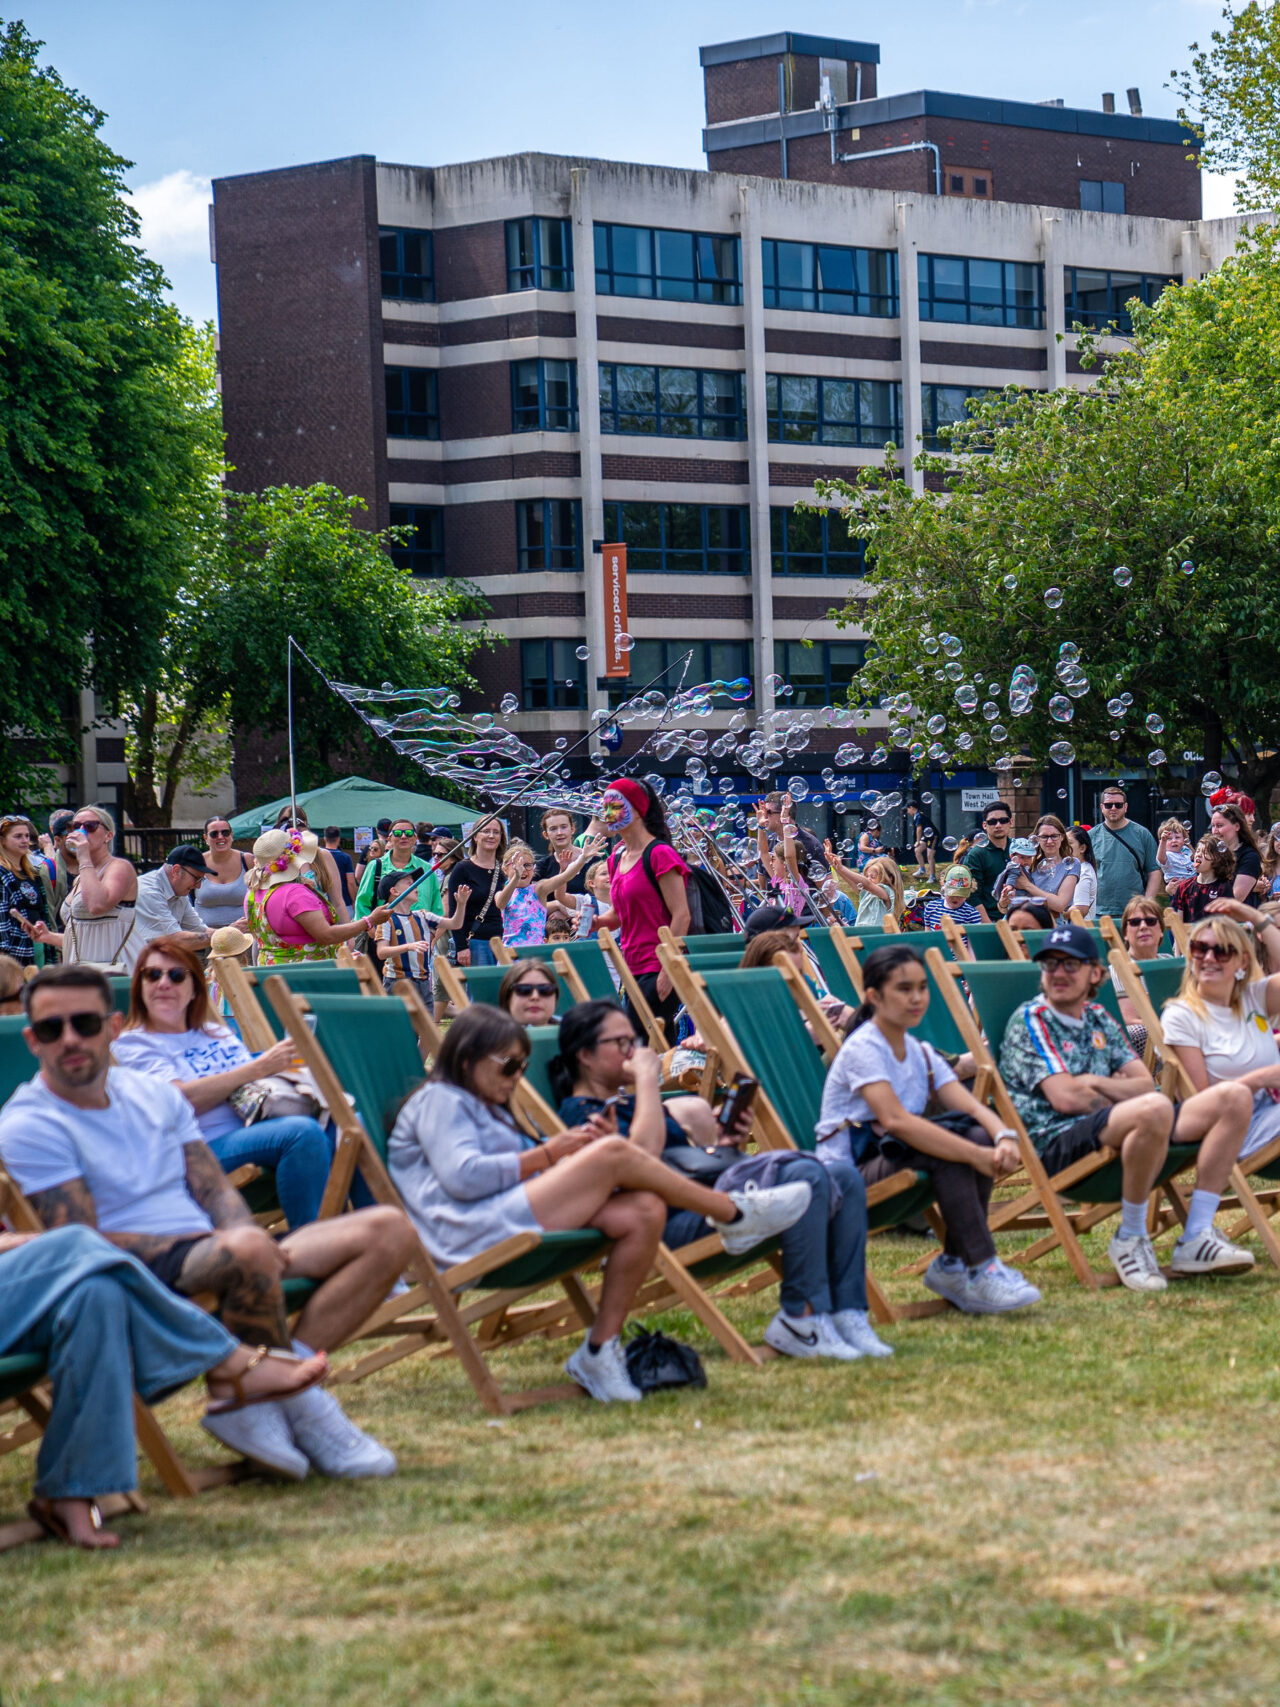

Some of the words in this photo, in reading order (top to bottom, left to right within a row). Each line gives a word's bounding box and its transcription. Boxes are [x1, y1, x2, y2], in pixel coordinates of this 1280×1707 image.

[612, 556, 621, 613] serviced
[965, 792, 980, 800] Town
[982, 792, 994, 800] Hall
[964, 800, 979, 808] West
